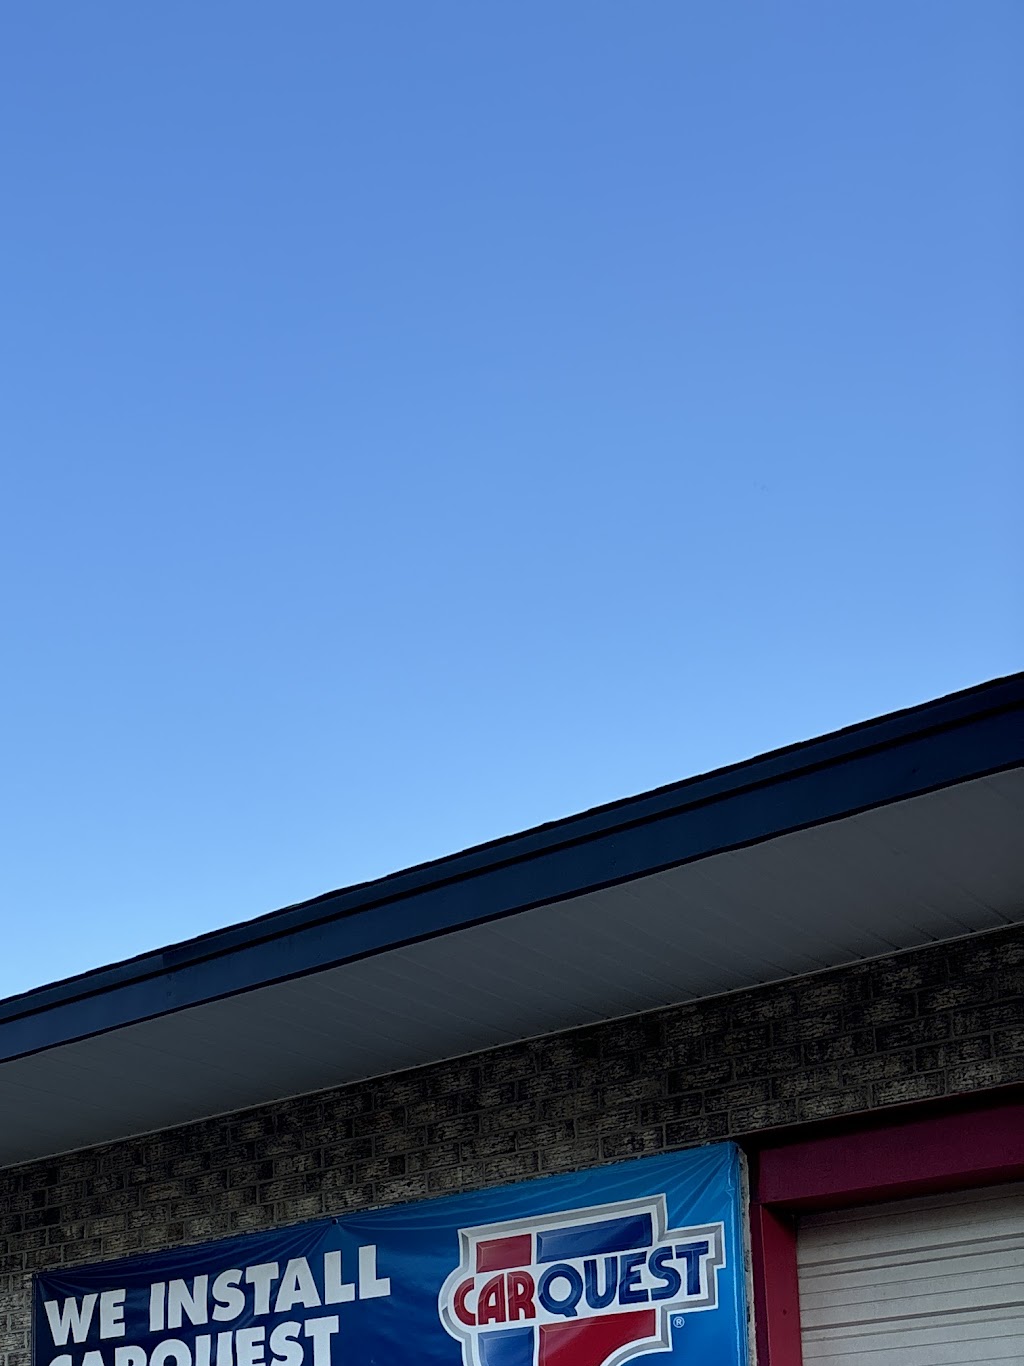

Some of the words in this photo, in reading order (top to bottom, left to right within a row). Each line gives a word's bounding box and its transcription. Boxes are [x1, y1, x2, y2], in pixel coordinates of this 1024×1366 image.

[44, 1288, 126, 1347] WE
[149, 1244, 391, 1332] INSTALL
[453, 1240, 710, 1326] CARQUEST
